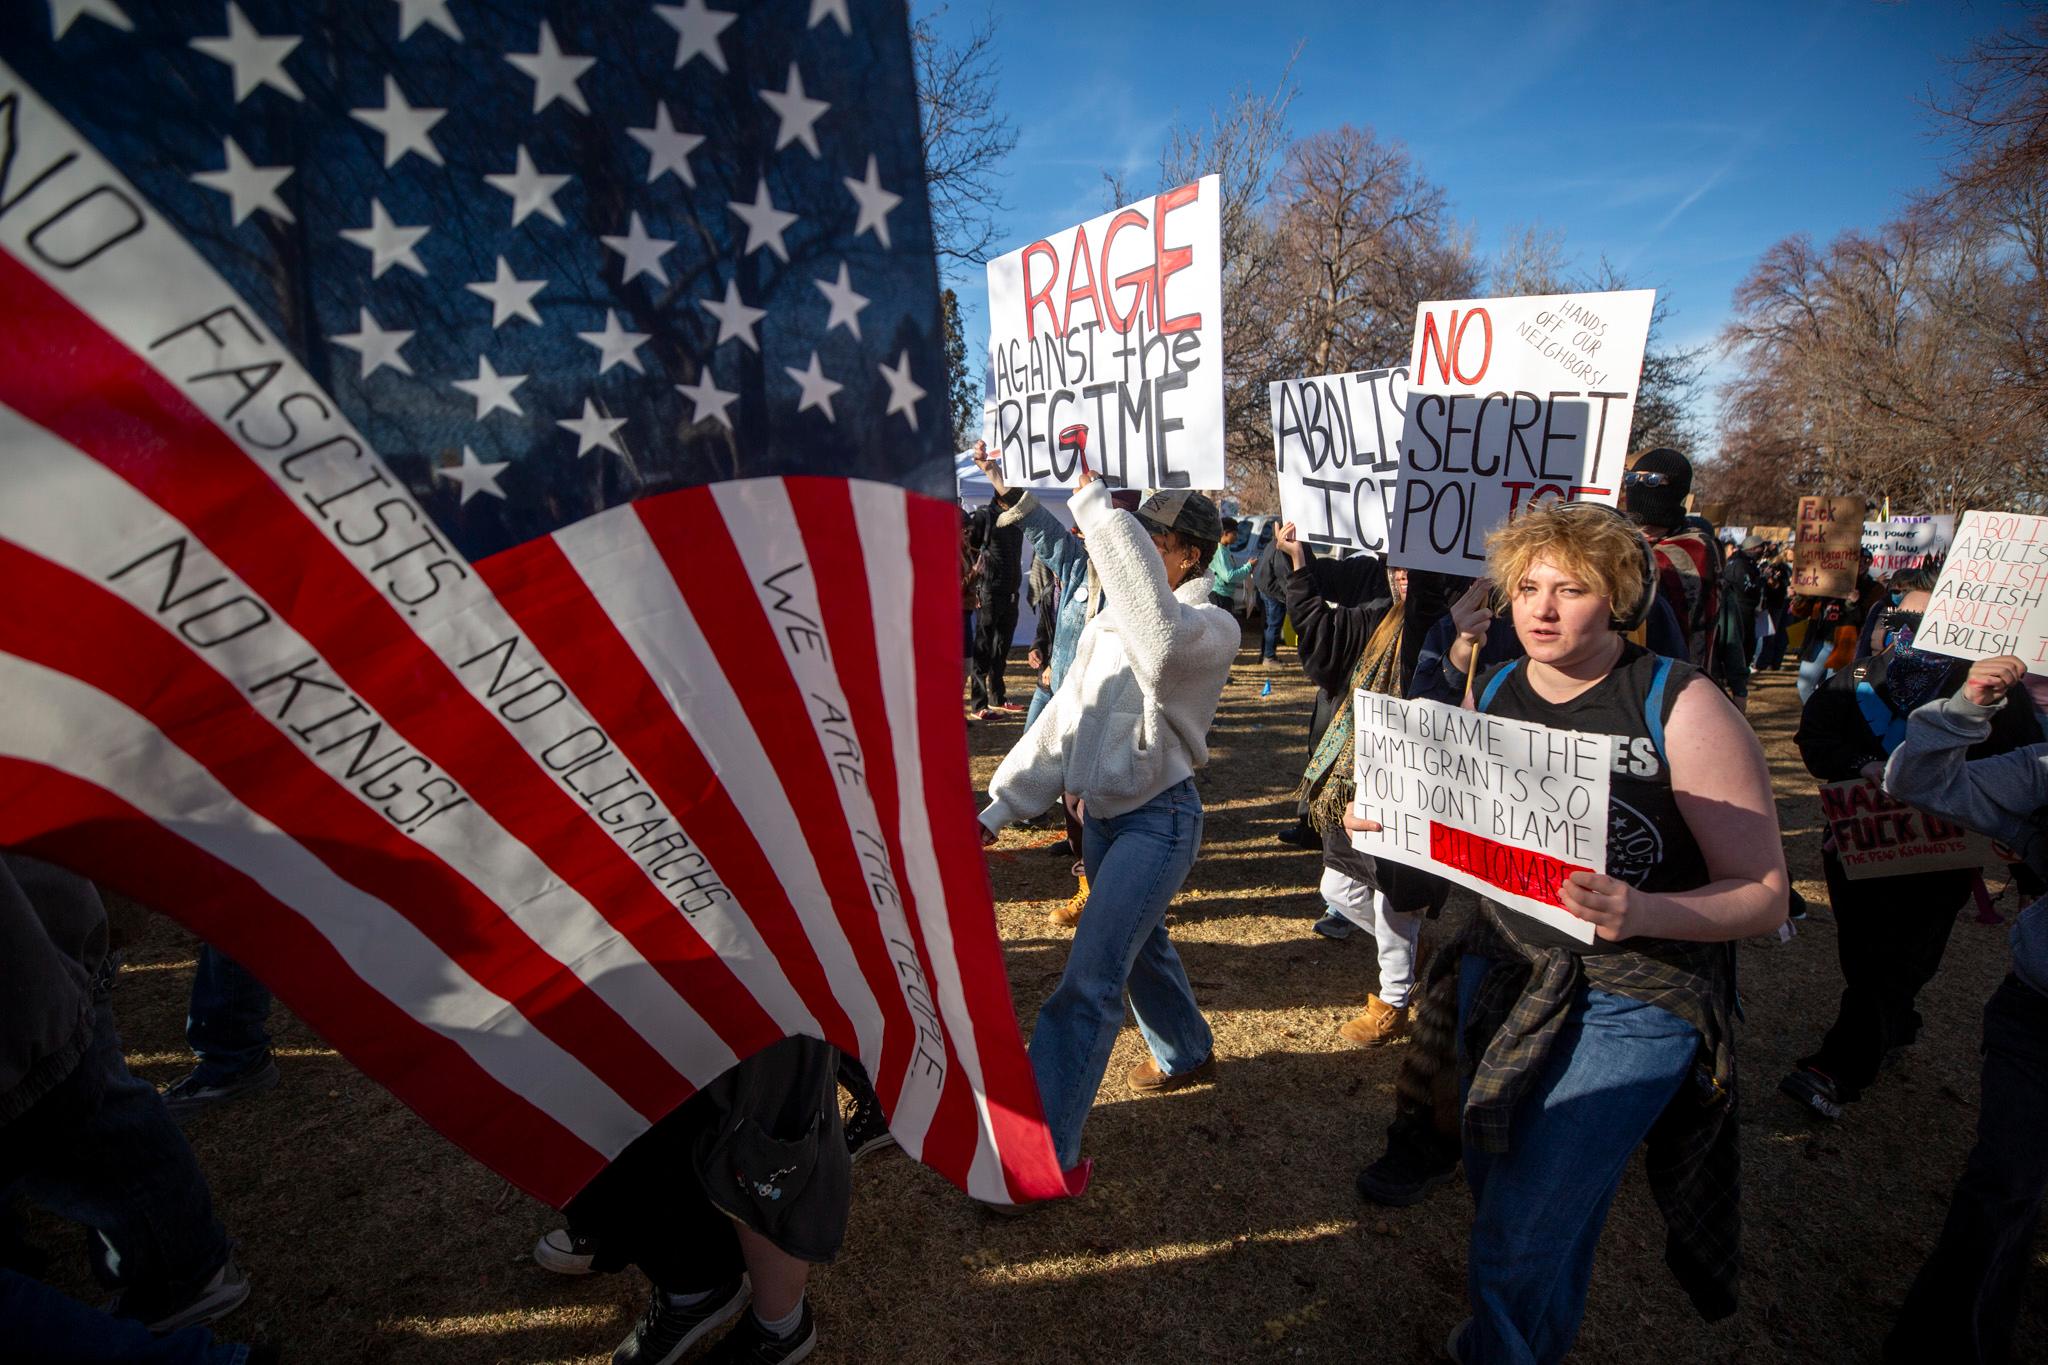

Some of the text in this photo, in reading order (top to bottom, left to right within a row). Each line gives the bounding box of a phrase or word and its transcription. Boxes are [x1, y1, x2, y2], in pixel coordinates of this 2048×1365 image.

[1021, 180, 1202, 342] RAGE
[997, 310, 1201, 400] AGANST the
[1416, 307, 1493, 386] NO
[1516, 320, 1608, 389] NEIGHBORS!
[1536, 311, 1602, 359] OFF OUR
[1559, 300, 1608, 337] HANDS
[998, 367, 1191, 488] REGIME
[1278, 367, 1409, 474] ABOLIS
[1408, 390, 1629, 484] SECRET
[1885, 530, 1918, 540] power
[1952, 536, 2048, 565] ABOLIS
[1960, 514, 2048, 545] ABOLI
[148, 304, 468, 617] FASCISTS.
[457, 635, 568, 723] NO
[540, 725, 732, 919] OLIGARCHS.
[1928, 599, 2029, 633] ABOLISH
[1935, 580, 2042, 608] ABOLISH
[1920, 621, 2018, 656] ABOLISH
[107, 537, 470, 834] NO KINGS!
[762, 562, 828, 662] WE
[811, 692, 864, 785] ARE
[856, 829, 900, 907] THE
[1358, 694, 1597, 782] THEY BLAME THE
[1360, 729, 1591, 820] IMMIGRANTS SO
[1358, 763, 1593, 862] YOU DONT BLAME
[1359, 802, 1421, 855] THE
